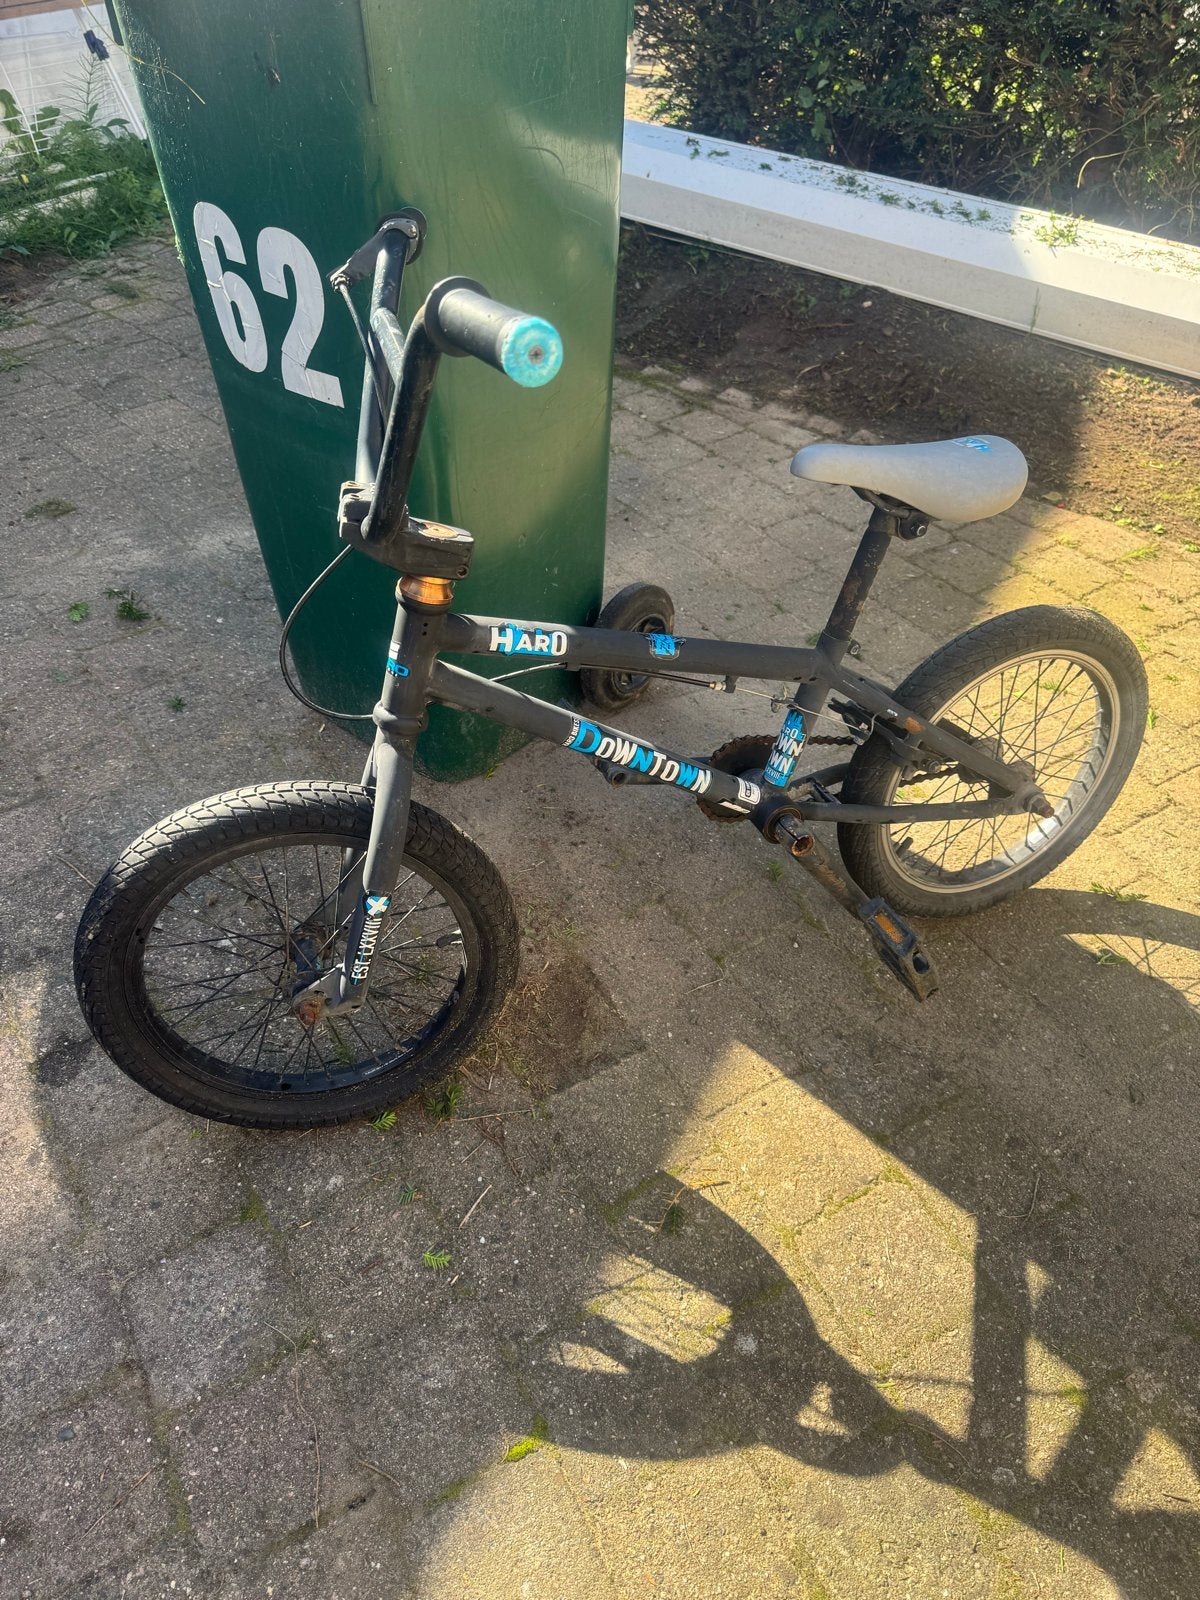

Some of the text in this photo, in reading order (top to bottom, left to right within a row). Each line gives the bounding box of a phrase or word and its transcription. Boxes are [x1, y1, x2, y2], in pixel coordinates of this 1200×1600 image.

[193, 201, 344, 408] 62
[489, 626, 568, 656] HARO
[569, 719, 713, 794] DOWNTOWN
[351, 958, 371, 979] EST.
